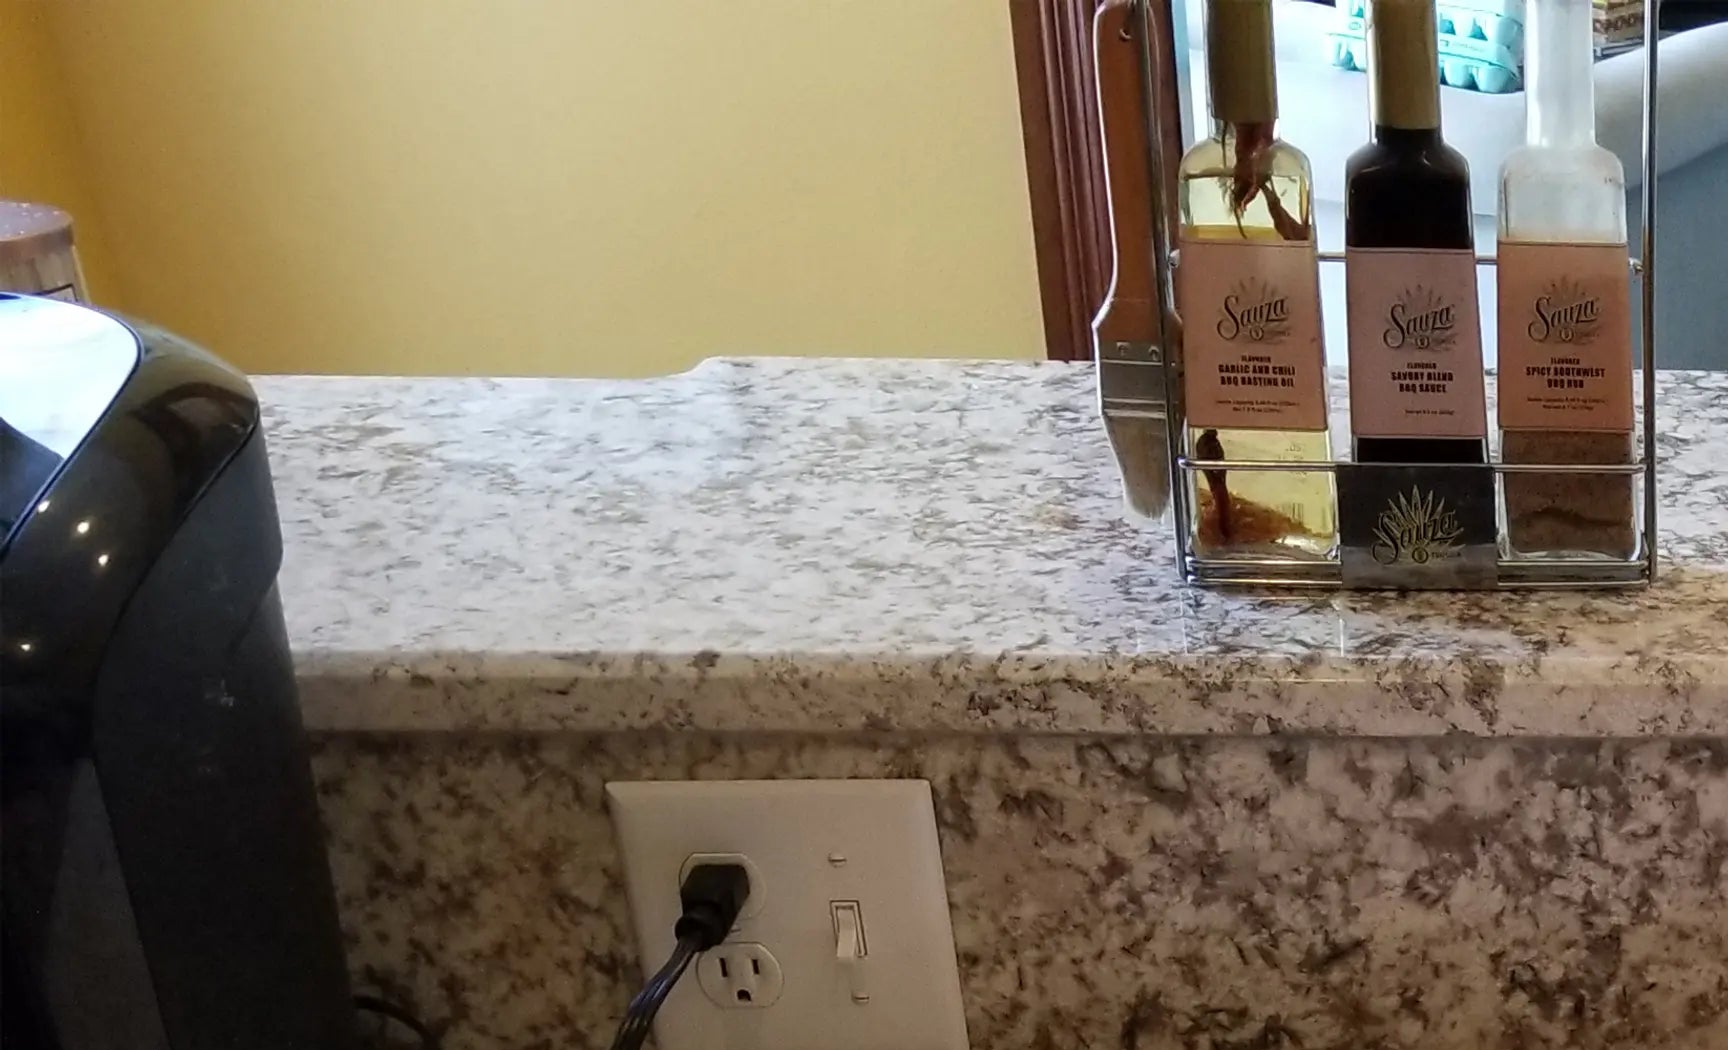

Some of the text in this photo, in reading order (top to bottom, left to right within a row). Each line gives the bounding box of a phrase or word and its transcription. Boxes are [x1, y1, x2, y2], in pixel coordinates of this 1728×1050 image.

[1217, 294, 1289, 341] Sauza
[1528, 295, 1599, 342] Sauza
[1383, 303, 1455, 349] Sauza
[1218, 363, 1296, 376] GARLIC AND CHILI
[1525, 366, 1551, 376] SPICY
[1241, 376, 1279, 388] BASTING
[1280, 377, 1295, 388] OIL
[1391, 371, 1454, 382] SAVORY BLEND
[1399, 383, 1447, 394] BBQ SAUCE
